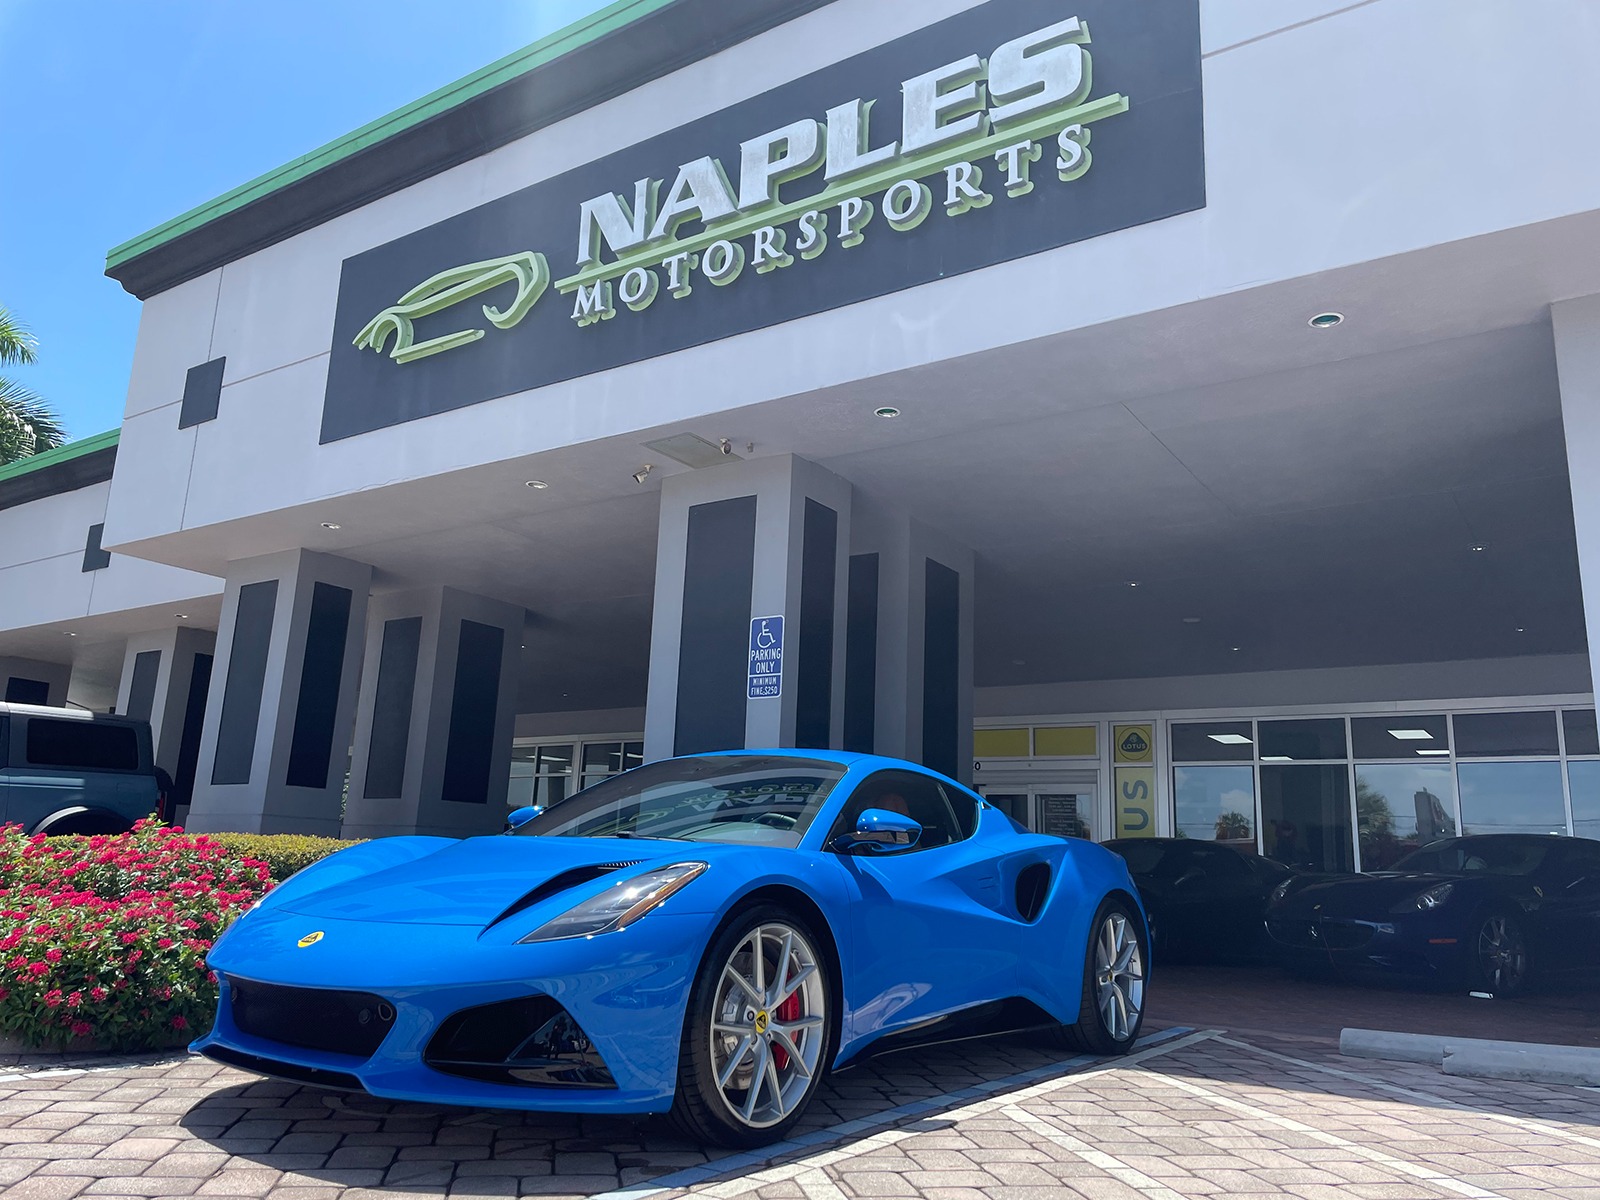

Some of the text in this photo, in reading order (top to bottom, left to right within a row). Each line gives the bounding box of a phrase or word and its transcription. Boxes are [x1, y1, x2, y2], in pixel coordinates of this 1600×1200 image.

[575, 15, 1090, 266] NAPLES
[572, 124, 1089, 325] MOTORSPORTS
[751, 648, 782, 660] PARKING
[756, 661, 775, 674] ONLY
[753, 676, 777, 686] MINIMUM
